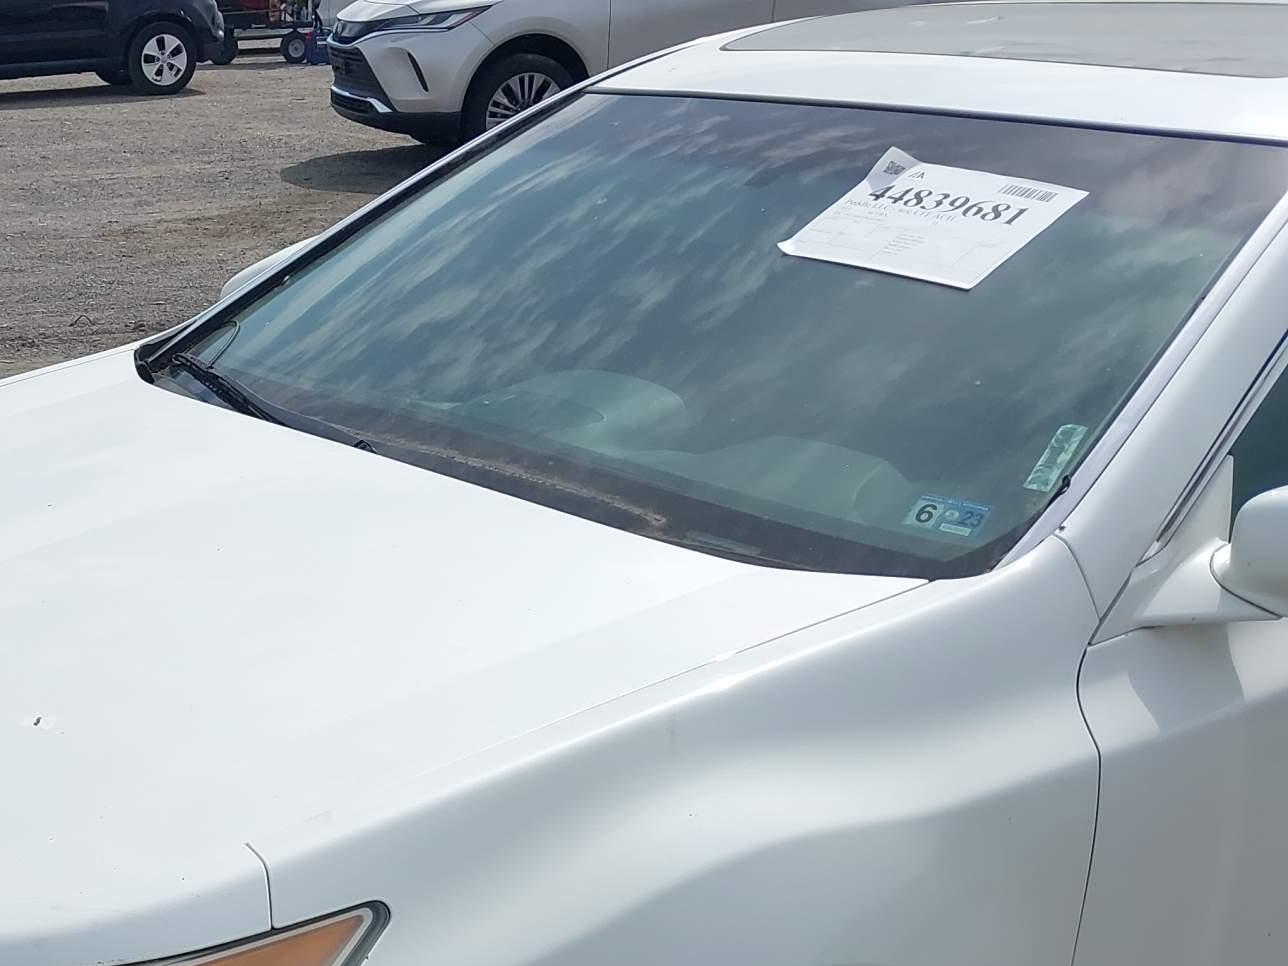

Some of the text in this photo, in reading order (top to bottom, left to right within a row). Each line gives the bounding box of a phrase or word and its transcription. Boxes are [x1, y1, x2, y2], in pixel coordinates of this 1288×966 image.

[868, 184, 1030, 225] 44839681
[915, 503, 938, 523] 6
[957, 510, 985, 528] 23
